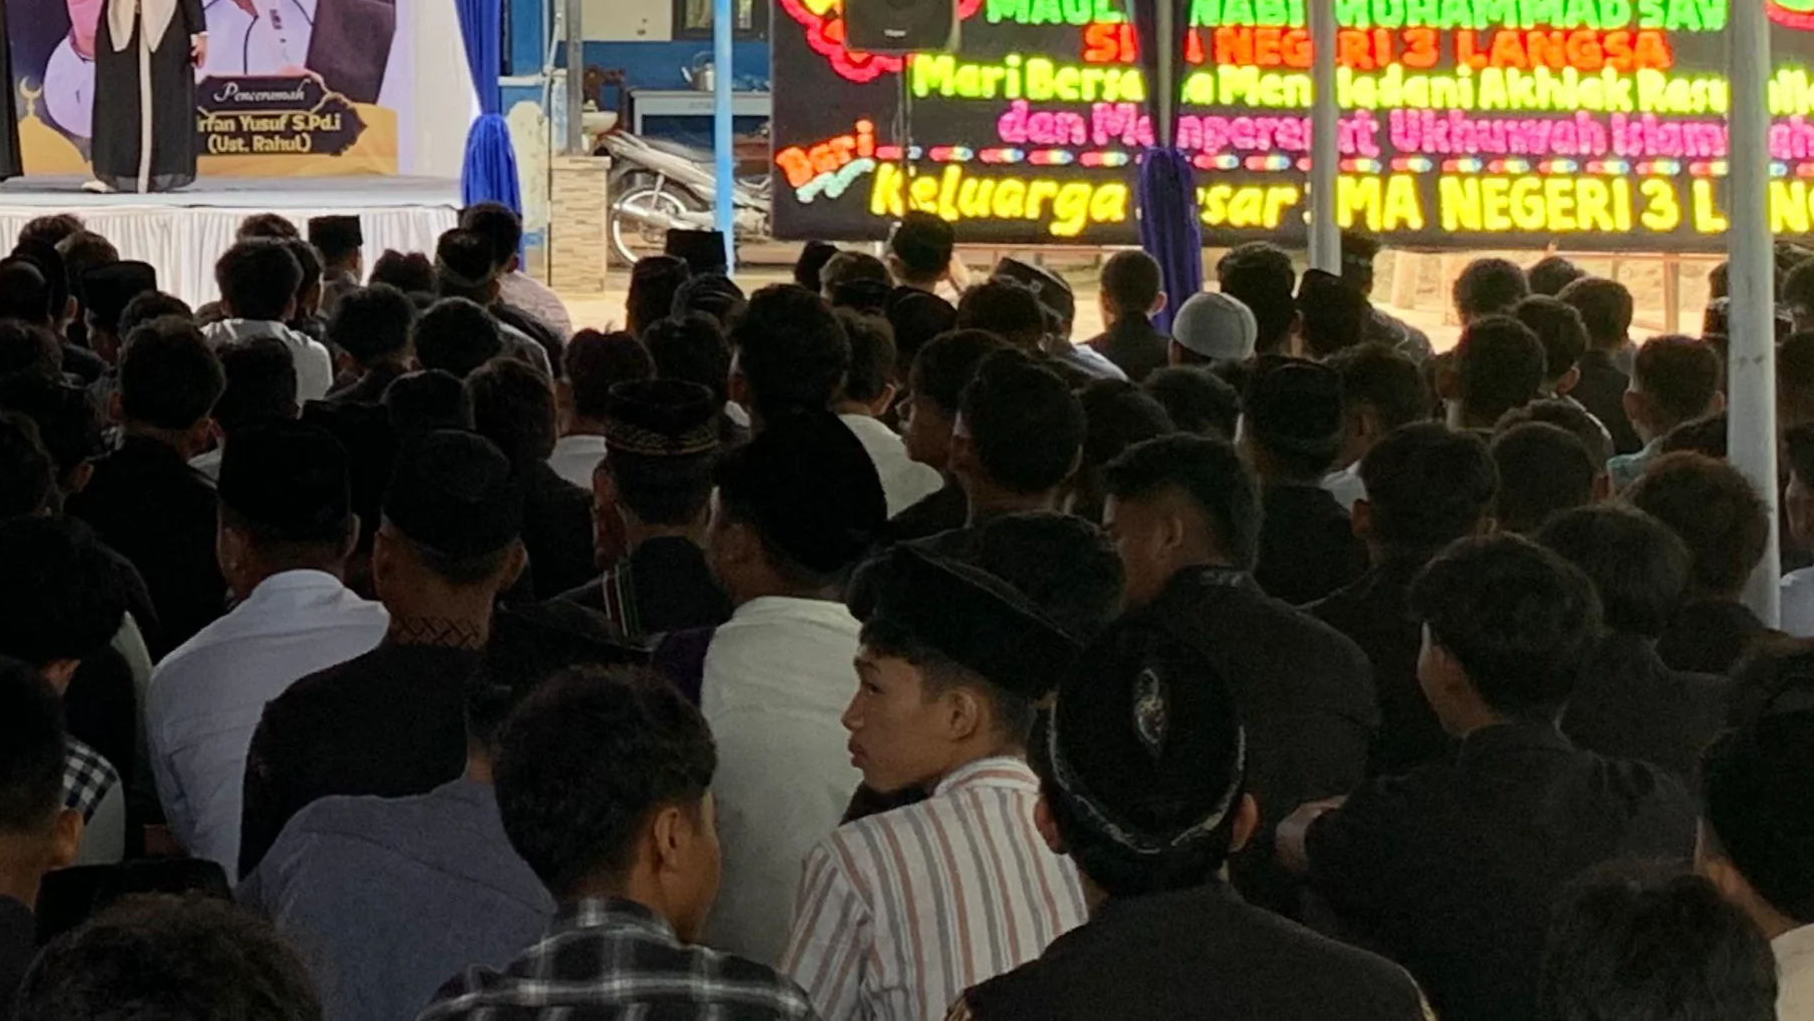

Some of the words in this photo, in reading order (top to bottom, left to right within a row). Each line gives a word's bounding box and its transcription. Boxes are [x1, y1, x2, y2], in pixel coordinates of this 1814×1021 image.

[1214, 26, 1391, 70] NEGRI
[1400, 28, 1439, 69] 3
[1455, 29, 1675, 74] LANGSA
[911, 53, 1023, 98] Mari
[1024, 58, 1214, 104] Bersaa
[1477, 64, 1634, 113] Akhlak
[239, 113, 289, 132] Yusuf
[292, 114, 341, 131] S.Pd.i
[252, 133, 312, 154] Rahul)
[997, 99, 1087, 146] dan
[775, 119, 874, 188] Dari
[870, 161, 1128, 237] Keluarga
[1437, 176, 1632, 232] NEGERI
[1639, 178, 1681, 232] 3
